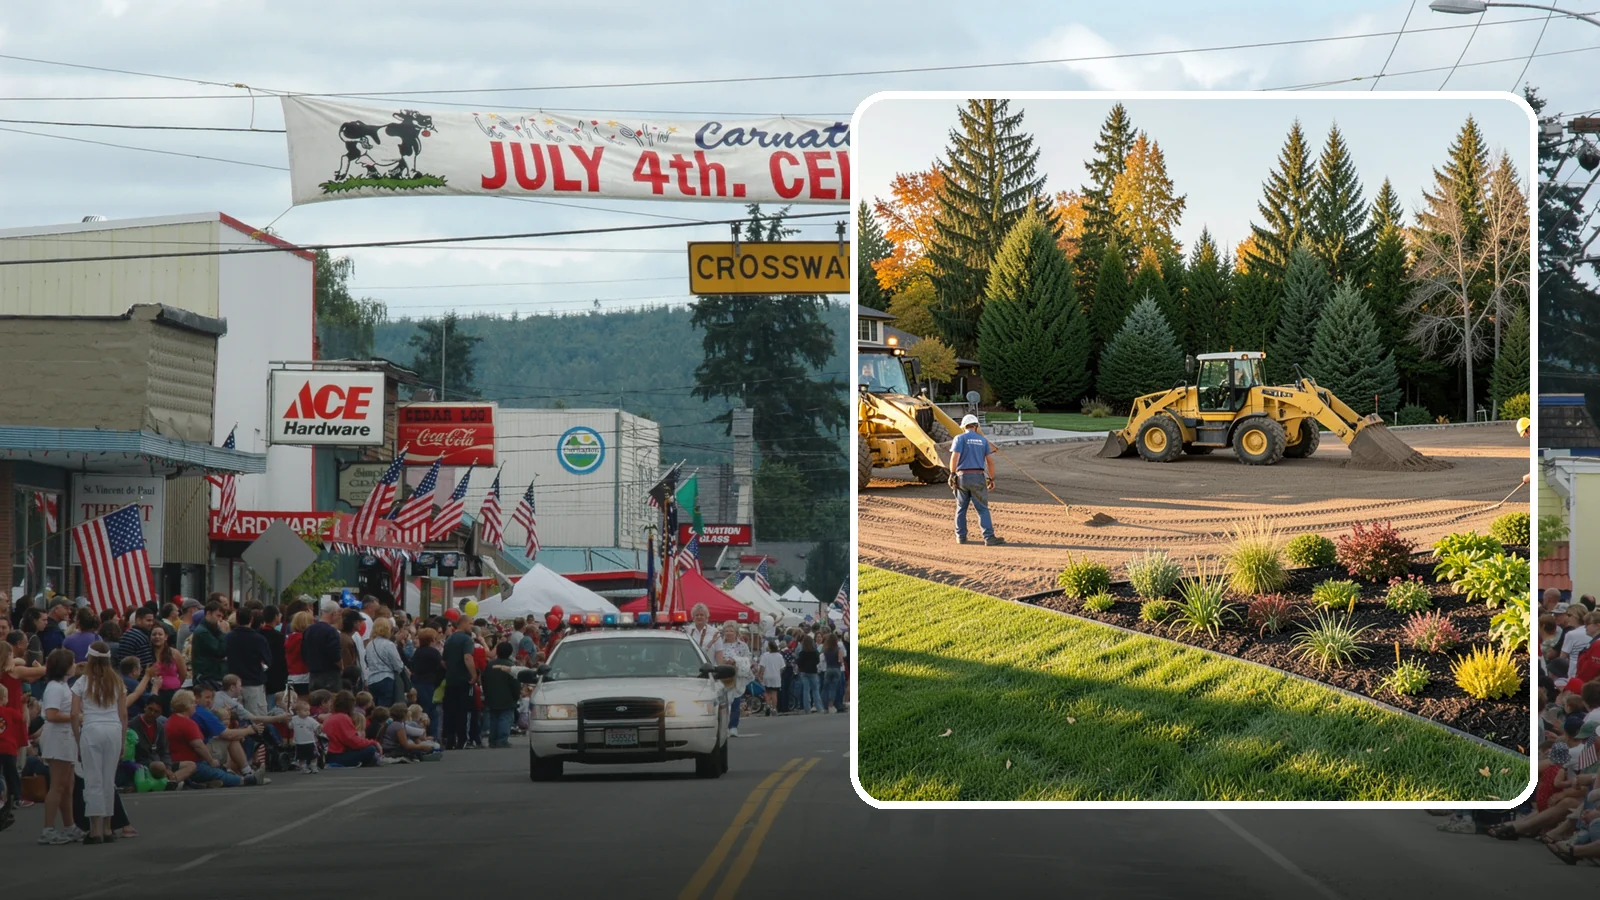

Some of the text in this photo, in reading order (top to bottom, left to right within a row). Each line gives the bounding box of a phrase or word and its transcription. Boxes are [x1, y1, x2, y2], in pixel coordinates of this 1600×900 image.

[481, 140, 605, 193] JULY
[632, 149, 747, 198] 4th.
[697, 254, 850, 280] CROSSWA
[282, 380, 373, 420] ACE
[405, 409, 452, 422] CEDAR
[283, 421, 371, 437] Hardware
[95, 485, 124, 495] Vincent
[126, 486, 136, 495] de
[137, 486, 155, 495] Paul
[212, 515, 331, 536] HARDARE
[688, 526, 742, 535] CRNATION
[699, 535, 731, 543] GLASS
